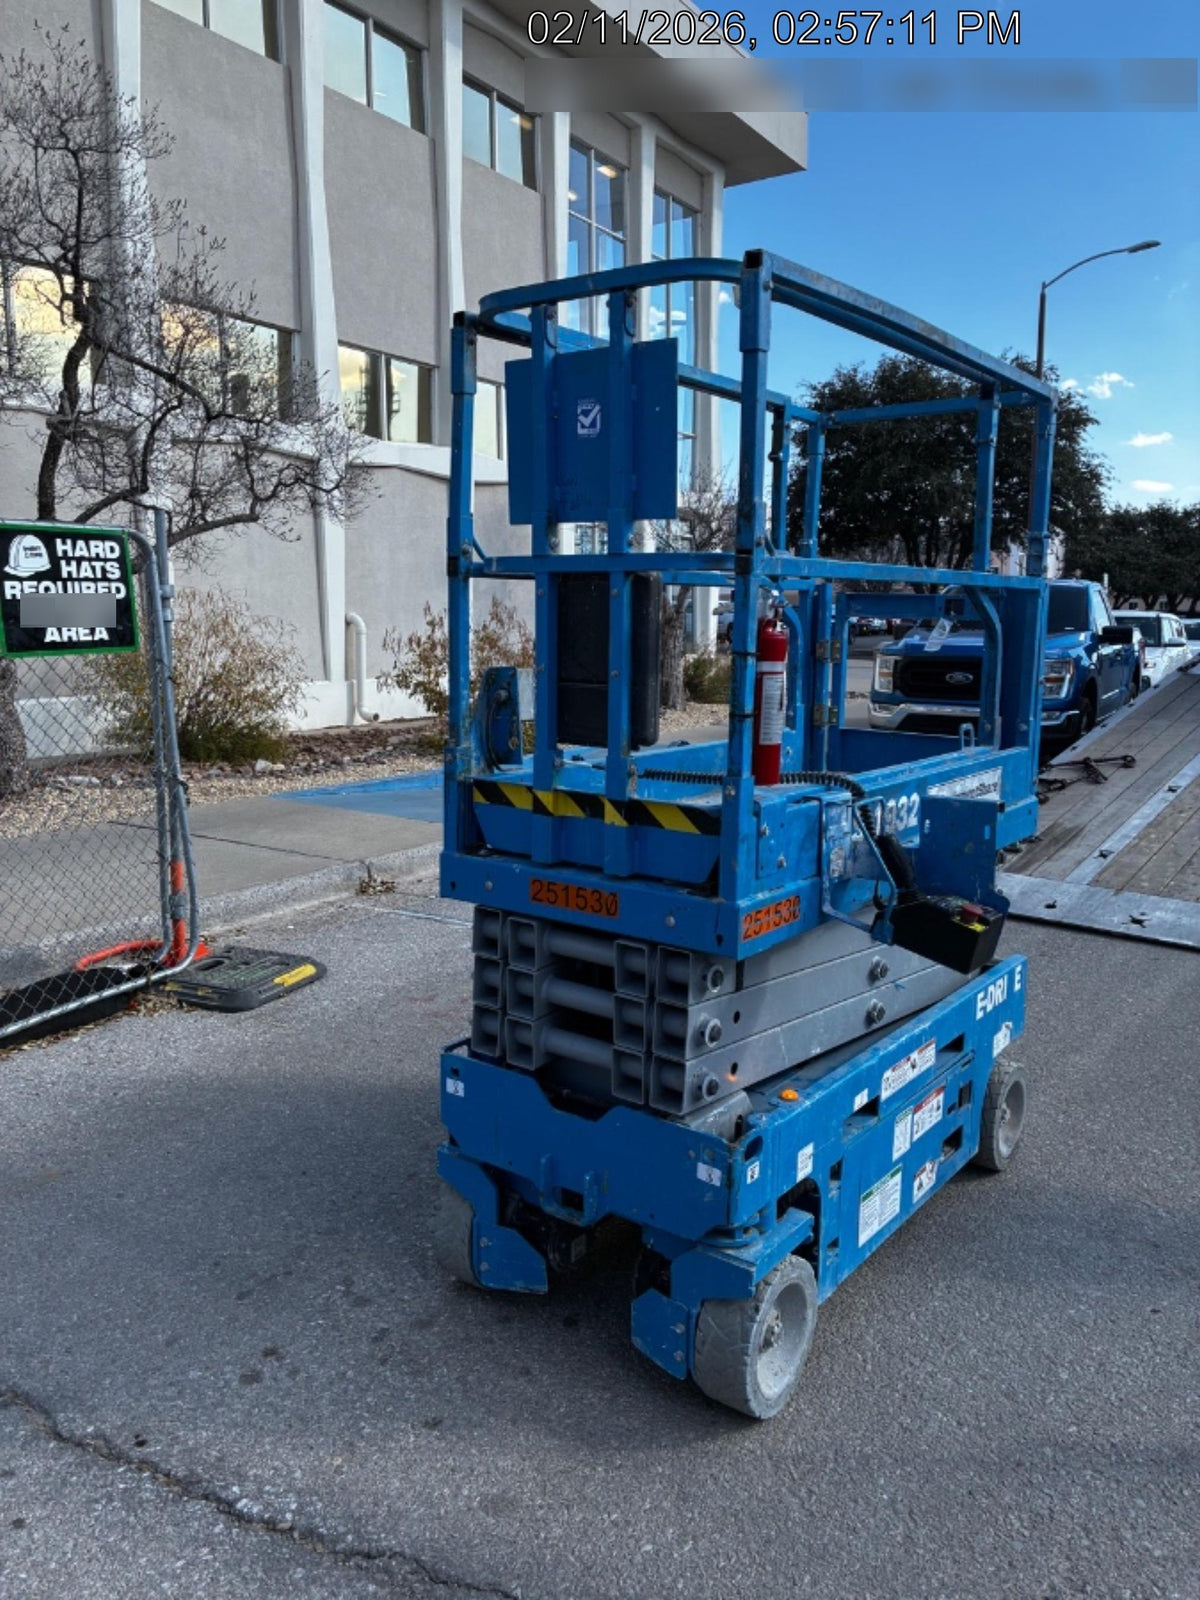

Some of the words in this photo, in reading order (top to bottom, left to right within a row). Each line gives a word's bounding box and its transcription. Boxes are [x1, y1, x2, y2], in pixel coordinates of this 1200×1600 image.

[55, 538, 120, 559] HARD
[60, 560, 121, 579] HATS
[3, 581, 126, 600] REQUIRED
[44, 627, 110, 642] AREA
[531, 879, 618, 916] 251530
[976, 965, 1022, 1021] E-DRIE
